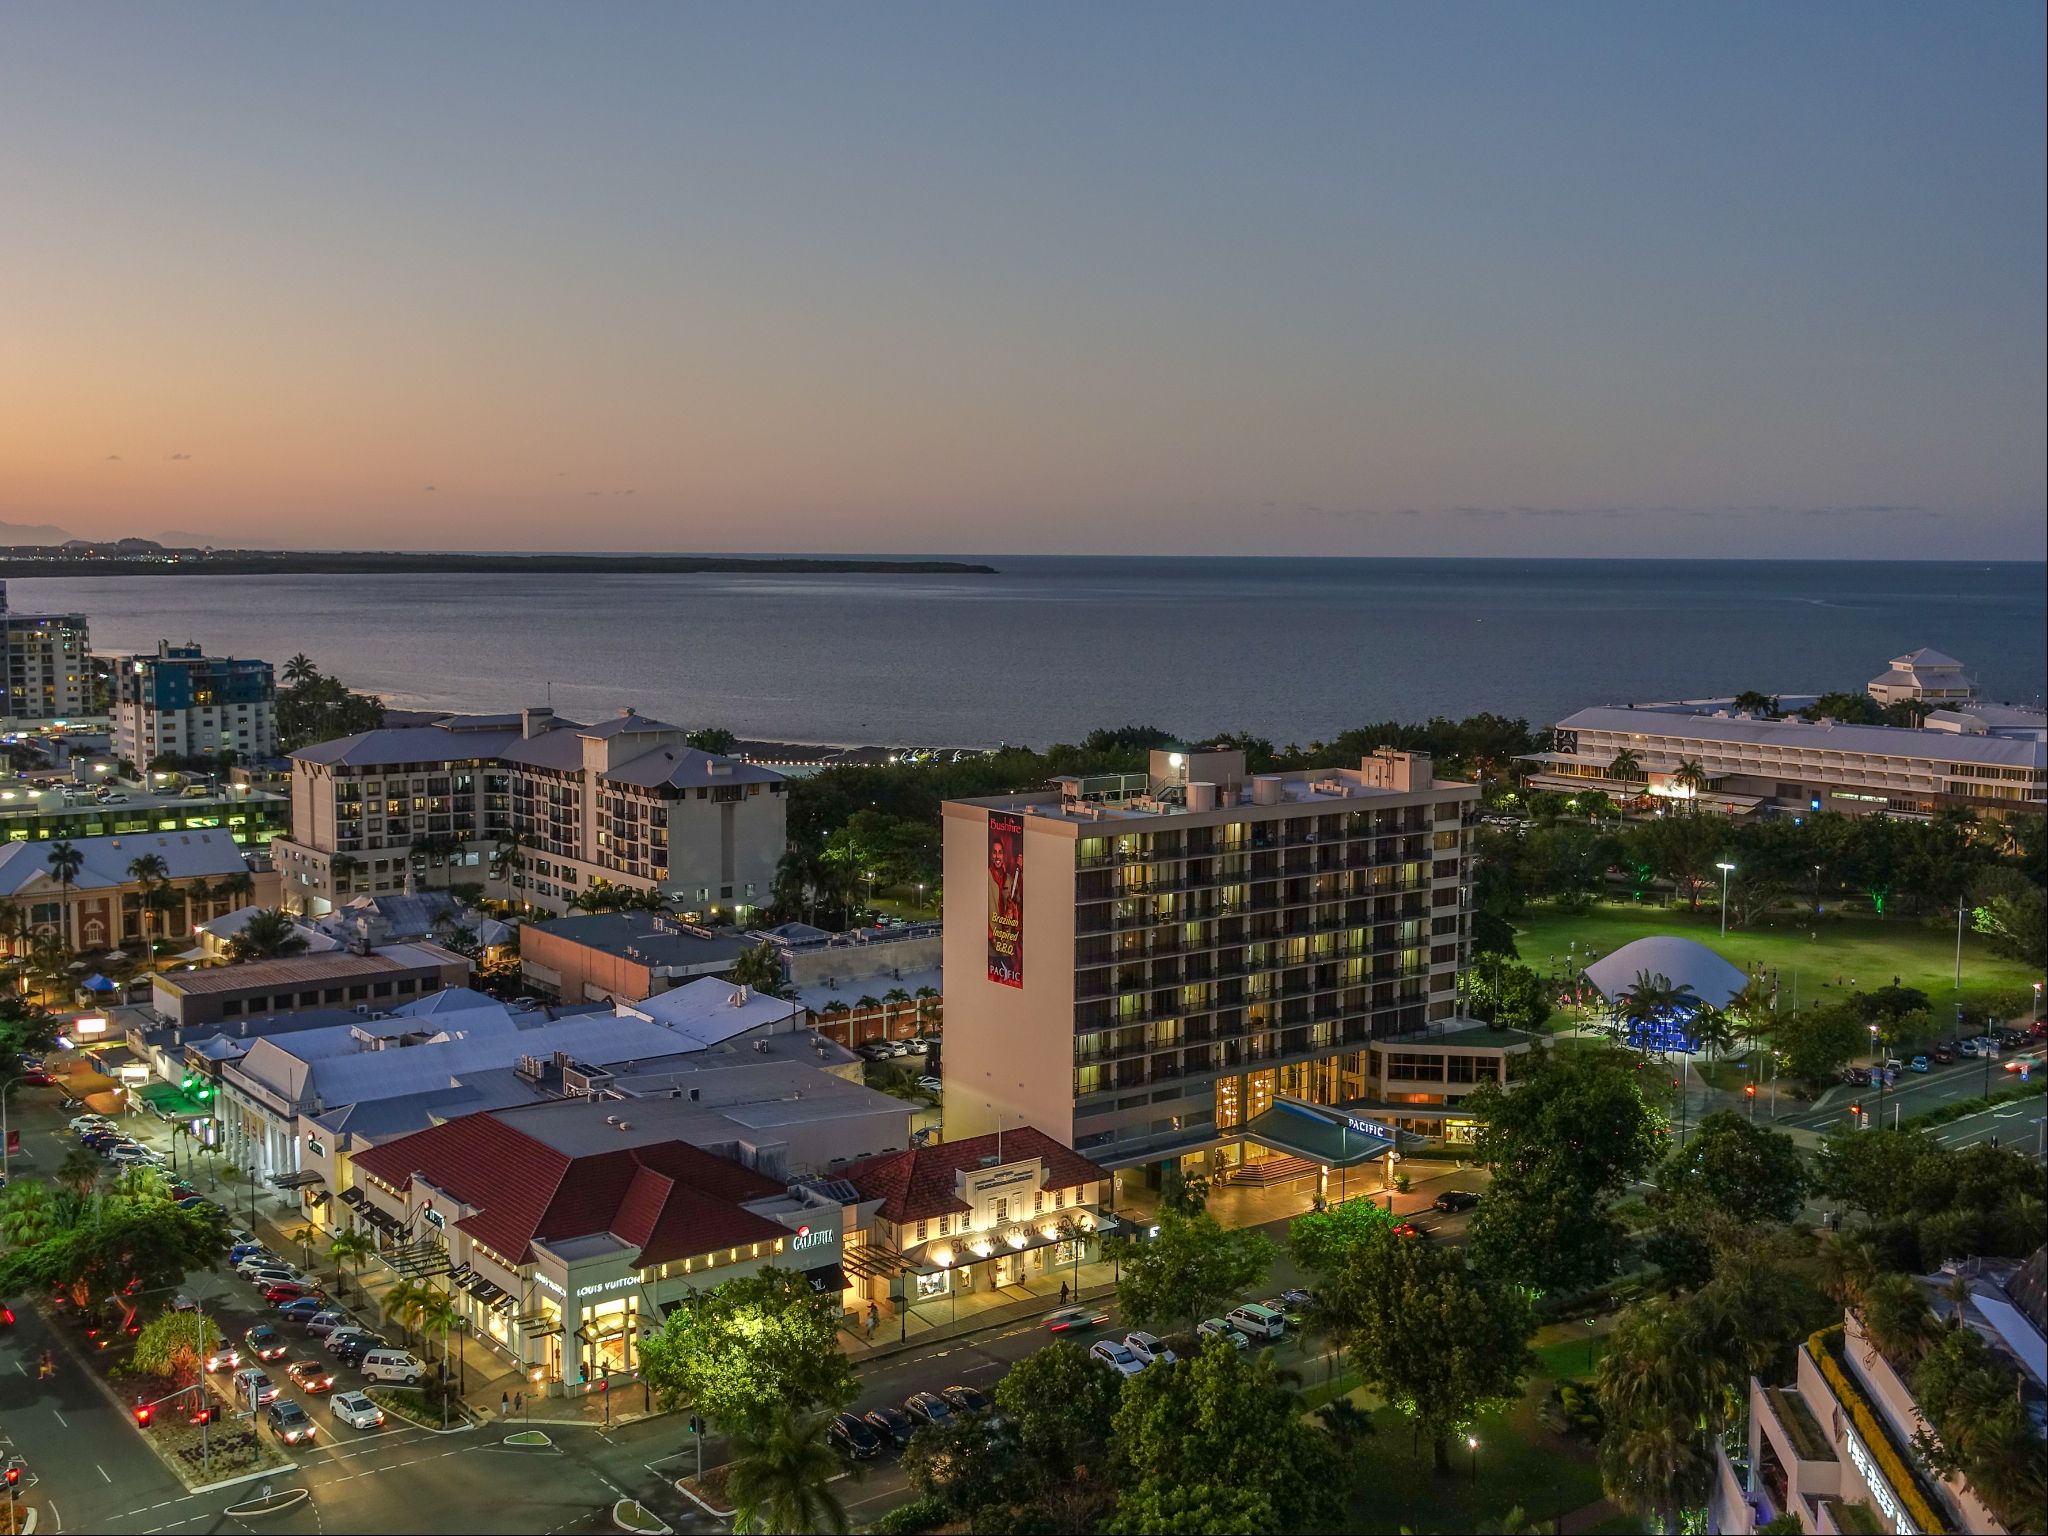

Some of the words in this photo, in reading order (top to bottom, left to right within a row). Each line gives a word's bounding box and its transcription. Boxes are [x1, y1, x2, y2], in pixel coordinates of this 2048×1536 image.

[991, 911, 1019, 927] Brazilian
[992, 926, 1020, 941] Inspired
[1348, 1118, 1384, 1137] PACIFIC
[793, 1229, 835, 1251] GALLERIA
[577, 1283, 604, 1297] LOUIS
[604, 1275, 642, 1291] VUITTON
